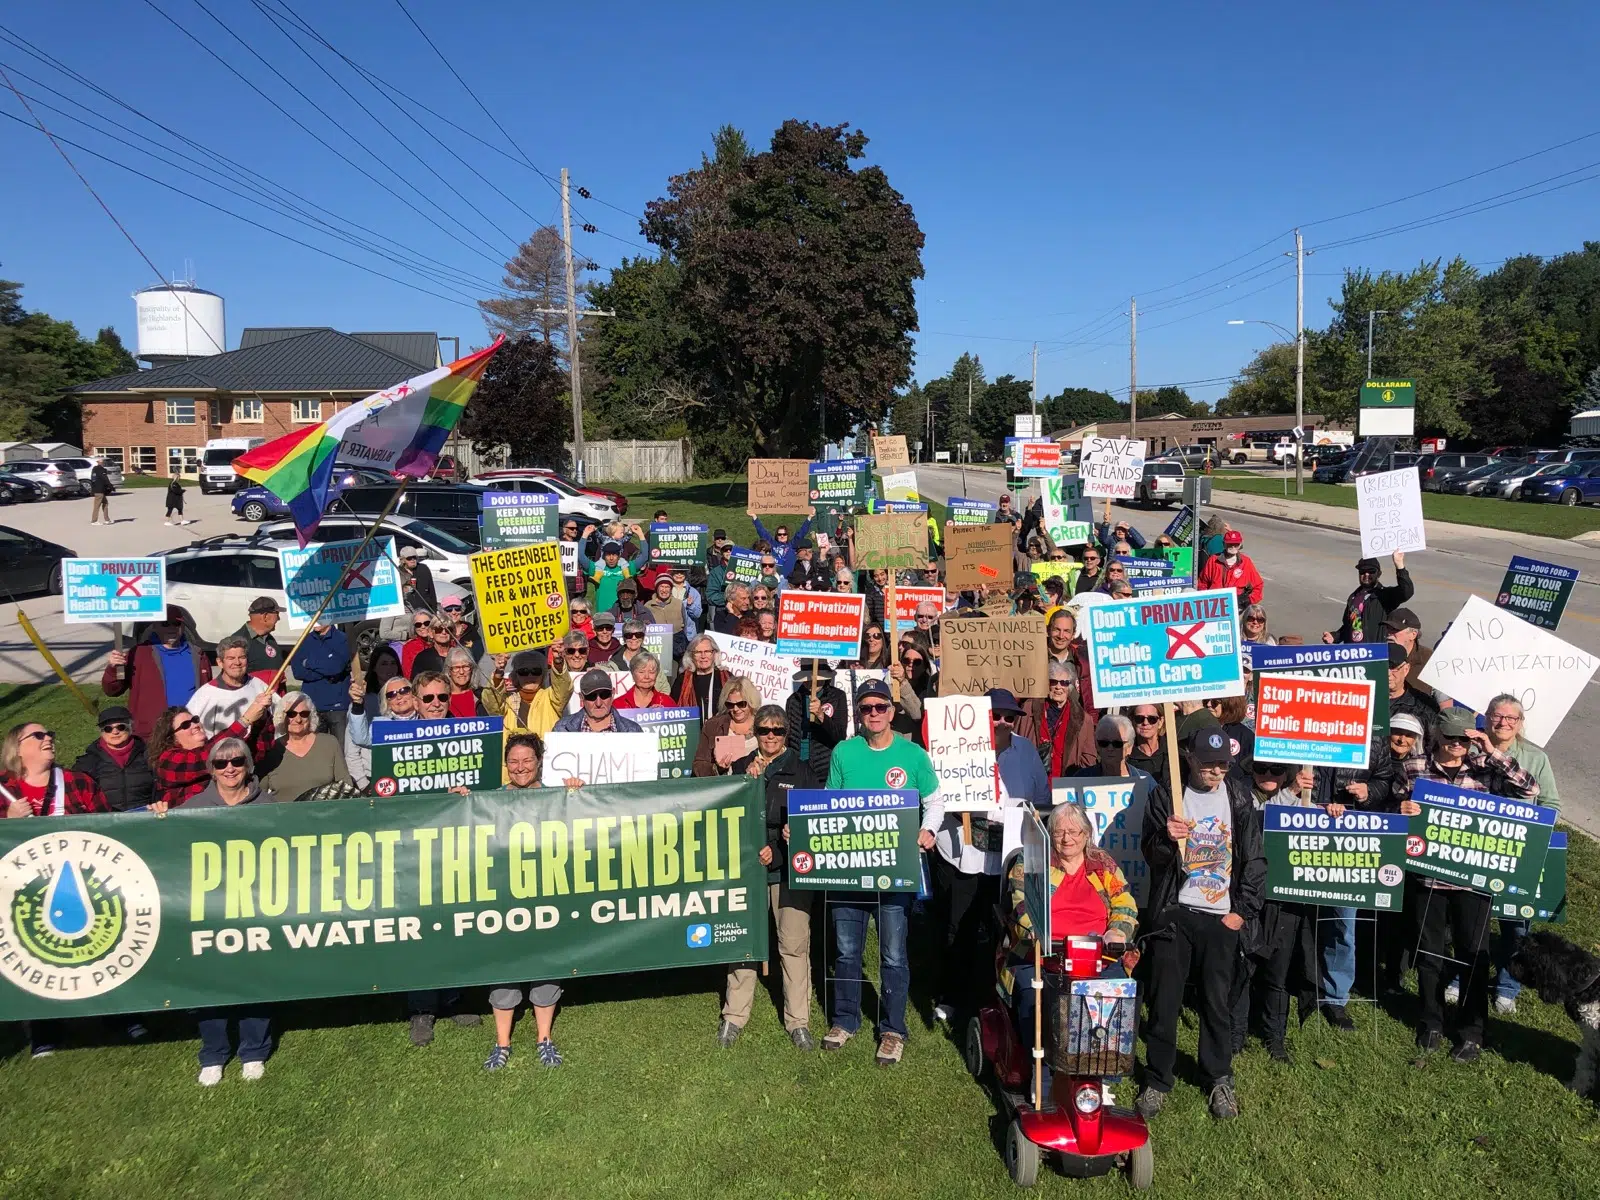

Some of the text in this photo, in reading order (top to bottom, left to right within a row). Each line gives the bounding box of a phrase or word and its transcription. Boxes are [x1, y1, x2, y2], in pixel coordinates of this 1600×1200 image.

[1092, 438, 1139, 456] SAVE
[1103, 455, 1120, 466] OUR
[817, 474, 835, 483] KEEP
[837, 473, 857, 481] YOUR
[1081, 462, 1142, 480] WETLANDS
[817, 481, 857, 490] GREENBELT
[1363, 470, 1414, 494] KEEP
[491, 495, 549, 506] DOUG FORD:
[820, 488, 856, 498] PROMISE!
[1366, 492, 1402, 509] THIS
[496, 507, 546, 518] KEEP YOUR
[497, 516, 546, 527] GREENBELT
[1062, 503, 1080, 522] IT
[499, 525, 545, 536] PROMISE!
[658, 533, 699, 542] KEEP YOUR
[1370, 526, 1420, 551] OPEN
[659, 541, 699, 549] GREENBELT
[855, 530, 922, 551] GREENBELT
[472, 544, 558, 574] THE GREENBELT
[660, 548, 697, 557] PROMISE!
[102, 562, 160, 575] PRIVATIZE
[1530, 564, 1571, 578] DOUG FORD:
[68, 576, 84, 584] Our
[486, 566, 553, 590] FEEDS OUR
[1513, 573, 1562, 591] KEEP YOUR
[69, 584, 107, 597] Public
[485, 580, 559, 606] AIR WATER
[1510, 584, 1560, 602] GREENBELT
[69, 598, 139, 611] Health Care
[513, 602, 537, 619] NOT
[783, 599, 860, 616] Stop Privatizing
[1508, 595, 1553, 612] PROMISE!
[1092, 597, 1230, 630] Don't PRIVATIZE
[781, 622, 858, 637] Public Hospitals
[944, 620, 1045, 634] SUSTAINABLE
[1467, 617, 1504, 641] NO
[504, 628, 556, 649] POCKETS
[951, 638, 1035, 651] SOLUTIONS
[1095, 630, 1117, 643] Our
[1204, 632, 1231, 645] Voting
[730, 640, 758, 653] KEEP
[1097, 642, 1152, 665] Public
[720, 651, 789, 676] Duffins Rouge
[966, 654, 1026, 668] EXIST
[1264, 648, 1373, 666] PREMIER DOUG FORD:
[1434, 654, 1591, 678] PRIVATIZATION
[952, 675, 1036, 694] WAKE UP
[1100, 663, 1203, 688] Health Care
[1263, 685, 1367, 709] Stop Privatizing
[636, 709, 690, 722] DOUG FORD:
[943, 703, 976, 731] NO
[1262, 703, 1280, 714] our
[384, 721, 490, 741] PREMIER DOUG FORD:
[1260, 715, 1364, 737] Public Hospitals
[391, 738, 484, 762] KEEP YOUR
[930, 736, 991, 758] For-Profit
[393, 753, 484, 778] GREENBELT
[933, 757, 996, 784] Hospitals
[398, 769, 480, 793] PROMISE!
[965, 784, 994, 802] First
[799, 794, 905, 812] PREMIER DOUG FORD:
[1424, 794, 1540, 820] PREMIER DOUG FORD:
[807, 814, 899, 835] KEEP YOUR
[1280, 812, 1389, 830] DOUG FORD:
[1427, 808, 1528, 841] KEEP YOUR
[809, 831, 900, 853] GREENBELT
[1288, 835, 1381, 852] KEEP YOUR
[1425, 825, 1526, 858] GREENBELT
[11, 839, 124, 869] KEEP THE
[814, 849, 897, 870] PROMISE!
[1288, 851, 1381, 868] GREENBELT
[1426, 842, 1517, 874] PROMISE!
[190, 806, 745, 922] PROTECT THE GREENBELT
[795, 877, 858, 885] GREENBELTPROMISE.CA
[1293, 867, 1376, 884] PROMISE!
[1272, 886, 1366, 902] GREENBELTPROMISE.CA
[191, 886, 748, 956] FOR WATER FOOD CLIMATE
[713, 922, 741, 931] SMALL
[713, 928, 748, 937] CHANGE
[714, 935, 737, 944] FUND
